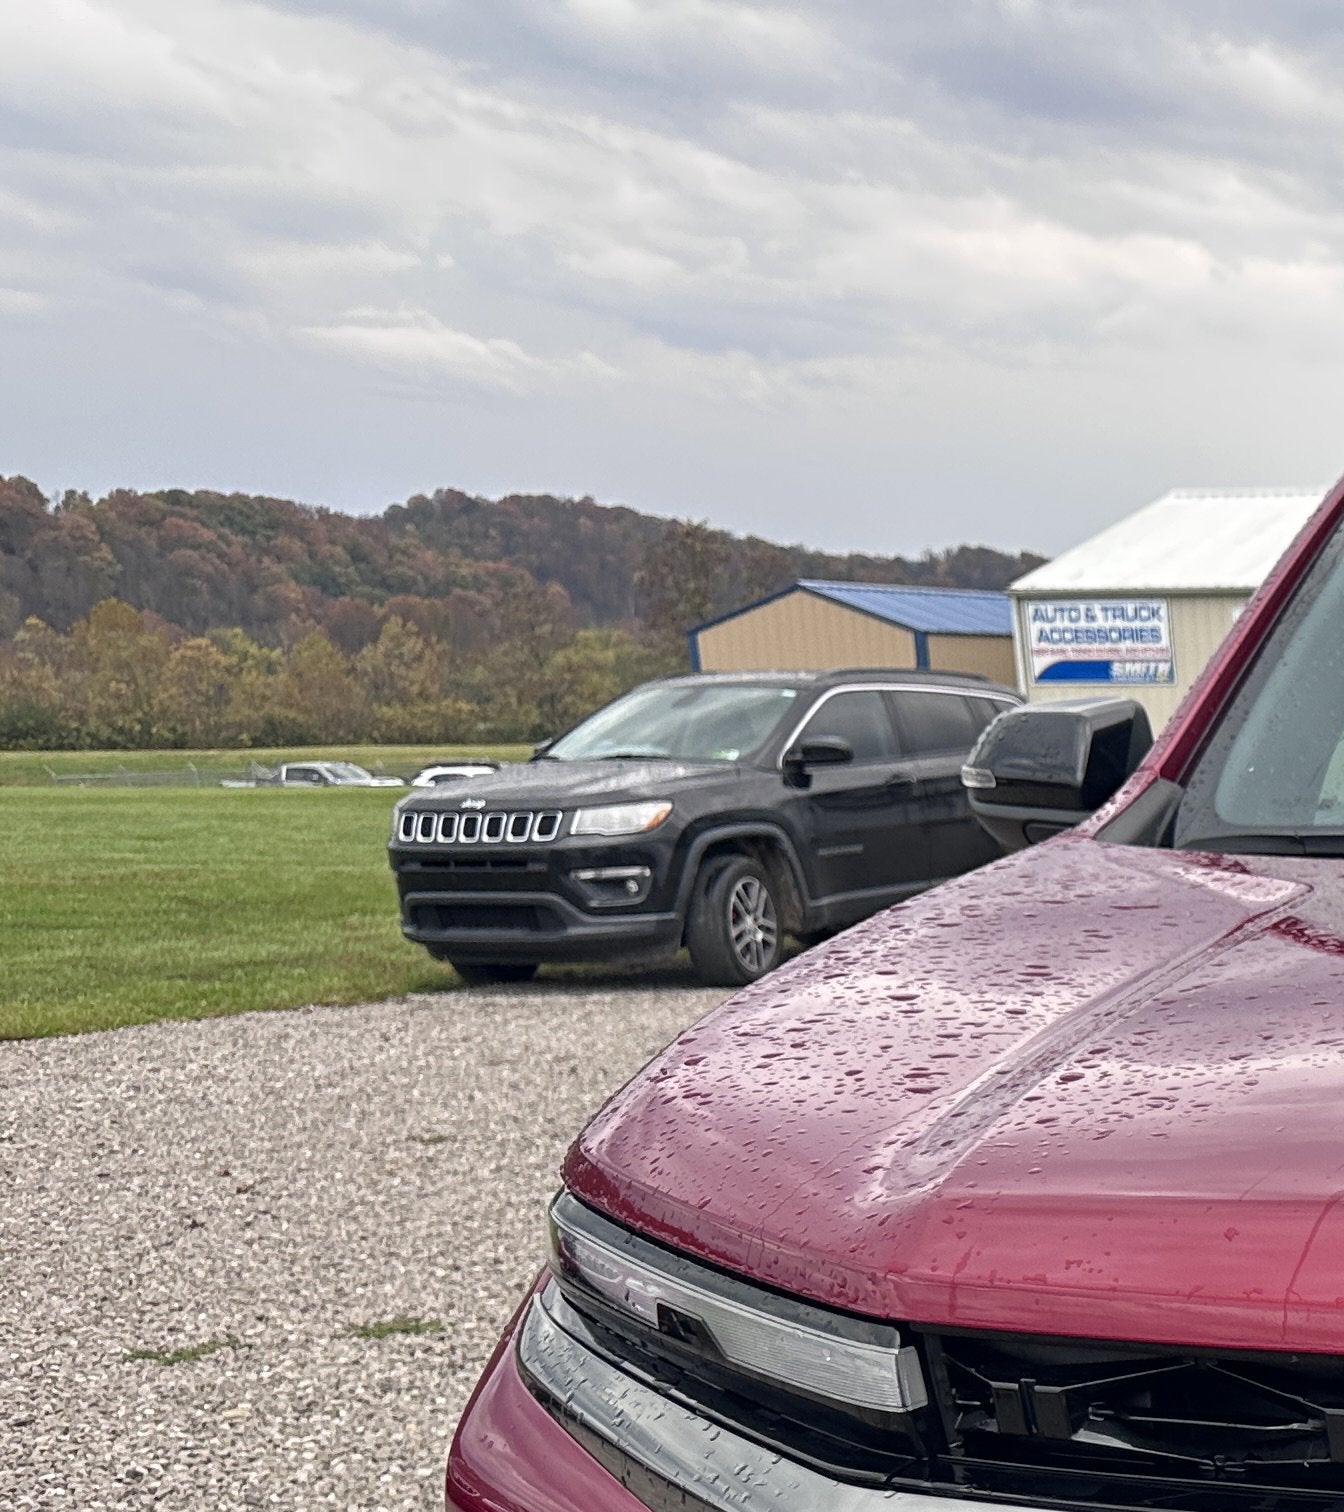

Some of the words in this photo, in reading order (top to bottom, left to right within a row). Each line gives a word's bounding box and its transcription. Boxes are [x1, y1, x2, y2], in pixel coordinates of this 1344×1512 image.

[1033, 607, 1080, 622] AUTO
[1085, 607, 1096, 622] &
[1101, 606, 1162, 622] TRUCK
[1038, 627, 1162, 643] ACCESSORIES
[1110, 662, 1170, 679] SMITH
